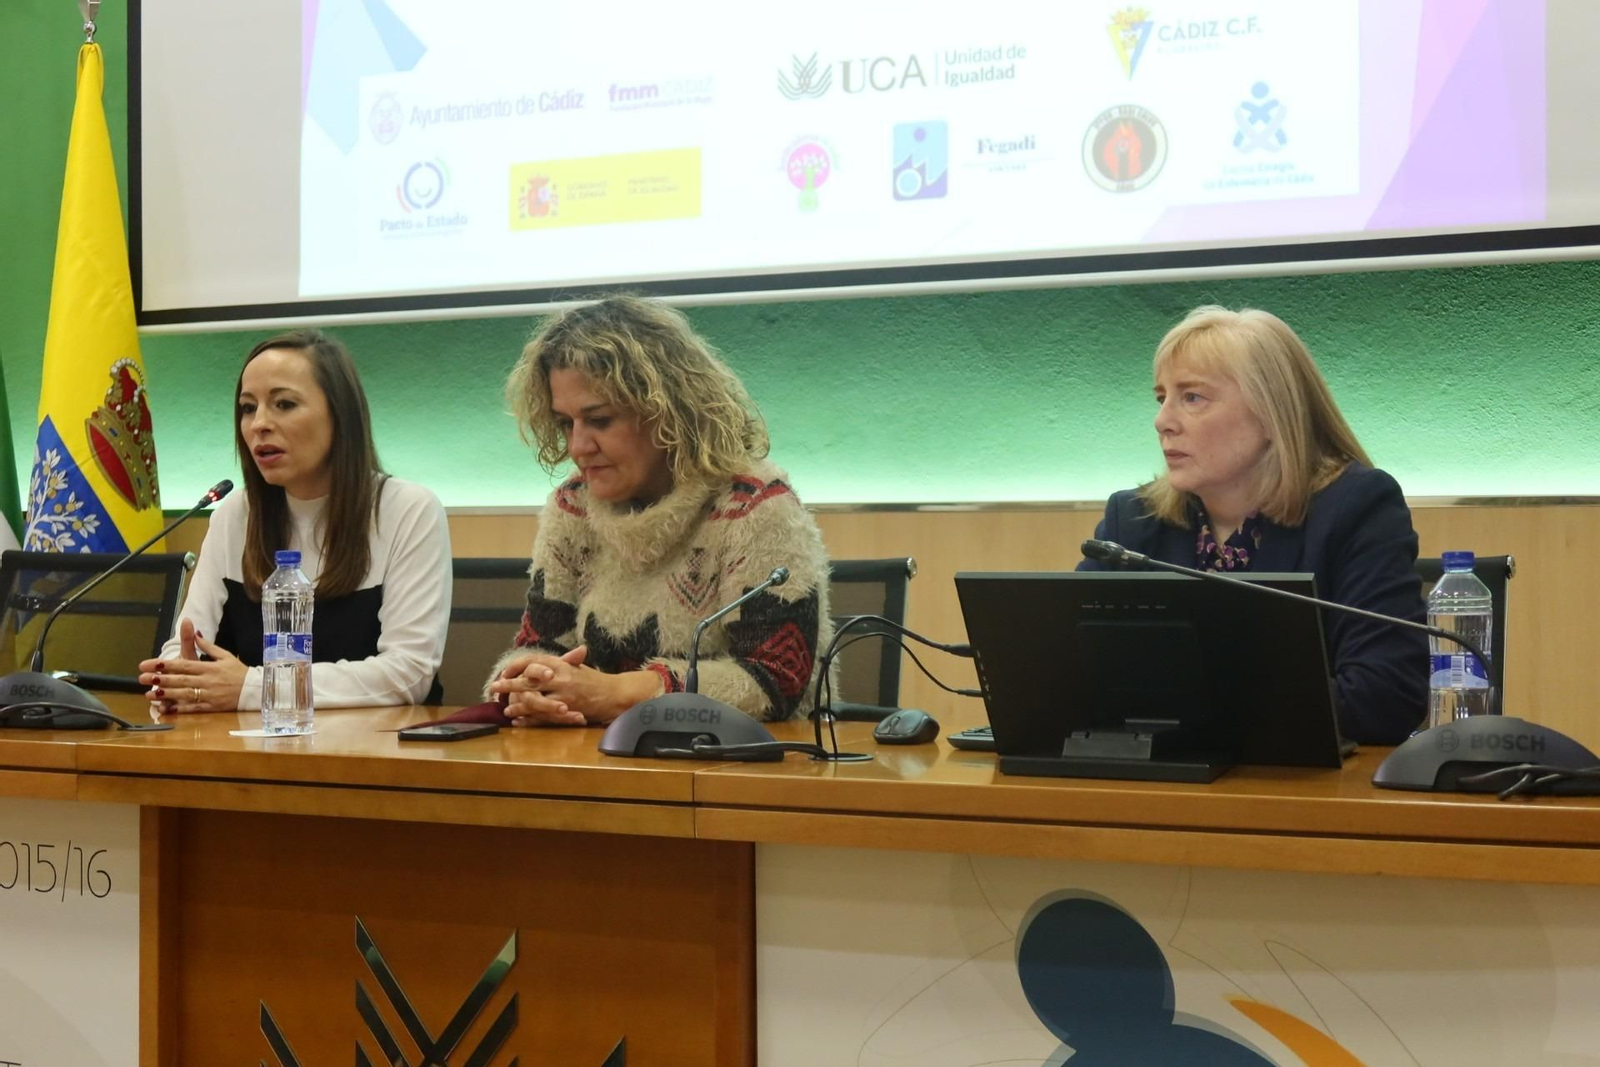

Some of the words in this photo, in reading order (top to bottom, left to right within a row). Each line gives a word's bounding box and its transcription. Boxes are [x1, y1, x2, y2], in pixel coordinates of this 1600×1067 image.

[1158, 19, 1220, 42] CÁDIZ
[1226, 16, 1263, 36] C.F.
[945, 43, 1002, 66] Unidad
[1006, 43, 1027, 61] de
[838, 53, 928, 94] UCA
[945, 63, 1015, 88] Igualdad
[608, 83, 660, 103] fmm
[409, 99, 512, 129] Ayuntamiento
[515, 95, 535, 117] de
[538, 88, 584, 114] Cádiz
[977, 134, 1037, 156] Fegadi
[380, 219, 414, 232] Pacto
[427, 213, 468, 228] Estado
[10, 684, 55, 698] BOSCH
[664, 706, 722, 725] BOSCH
[1470, 734, 1546, 753] BOSCH
